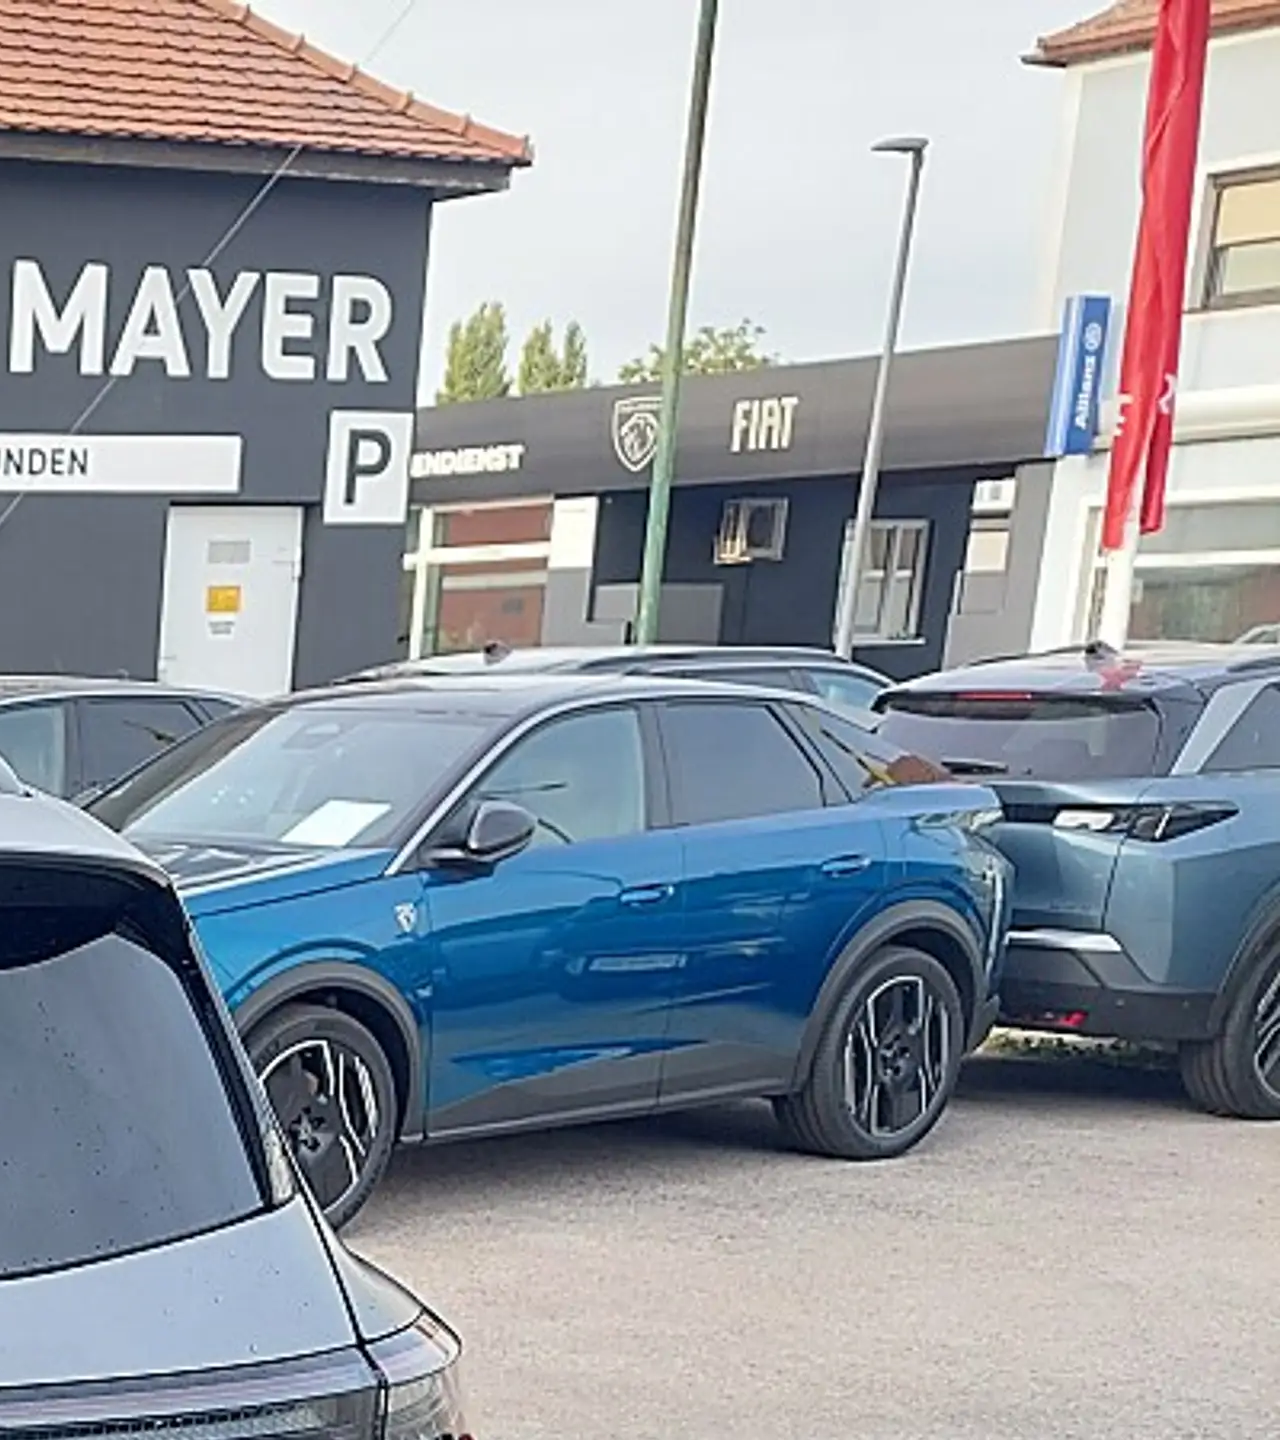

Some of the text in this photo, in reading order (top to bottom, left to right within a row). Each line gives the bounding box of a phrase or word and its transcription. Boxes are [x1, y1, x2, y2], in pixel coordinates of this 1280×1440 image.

[8, 258, 393, 383] MAYER
[730, 396, 800, 453] FIAT
[1073, 355, 1097, 431] Allianz
[344, 428, 392, 506] P
